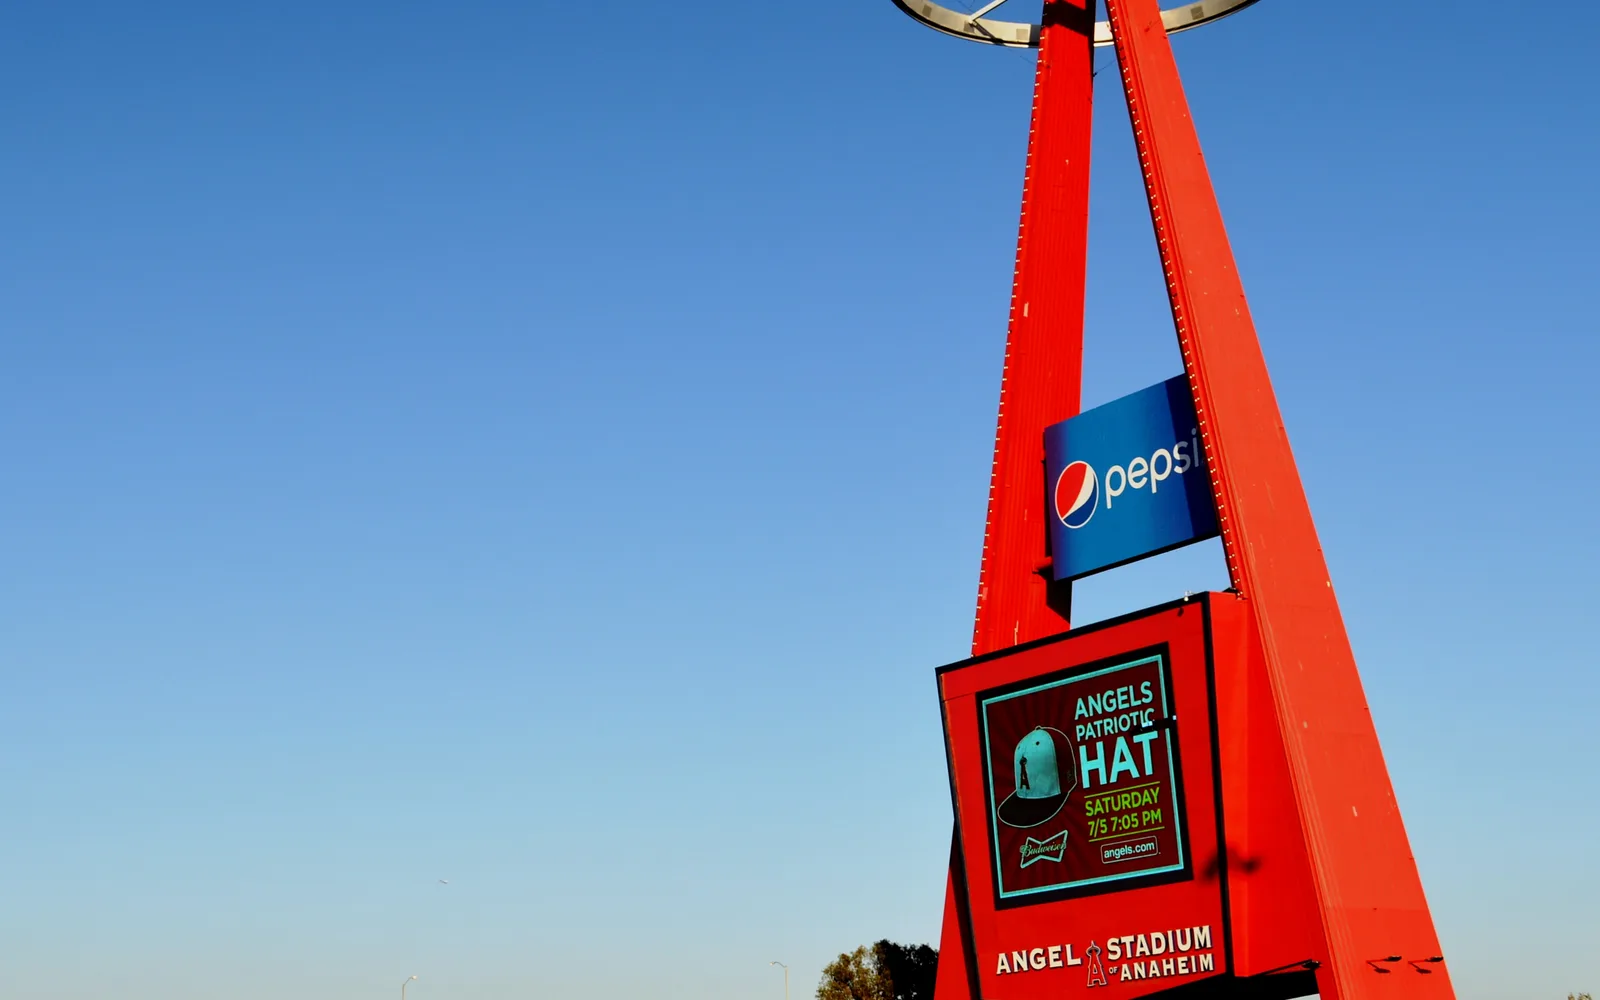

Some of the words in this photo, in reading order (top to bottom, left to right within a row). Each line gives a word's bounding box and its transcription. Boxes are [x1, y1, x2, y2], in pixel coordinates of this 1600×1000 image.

[1105, 428, 1200, 509] pepsi
[1075, 681, 1153, 720] ANGELS
[1076, 708, 1155, 742] PATRIOTIC
[1079, 731, 1158, 789] HAT
[1084, 787, 1160, 817] SATURDAY
[1088, 817, 1108, 838] 7/5
[1110, 814, 1139, 832] 7:05
[1142, 808, 1162, 826] PM
[1103, 841, 1155, 860] angels.com
[996, 944, 1082, 975] ANGEL
[1107, 925, 1212, 960] STADIUM
[1109, 966, 1118, 975] OF
[1120, 953, 1214, 982] ANAHEIM
